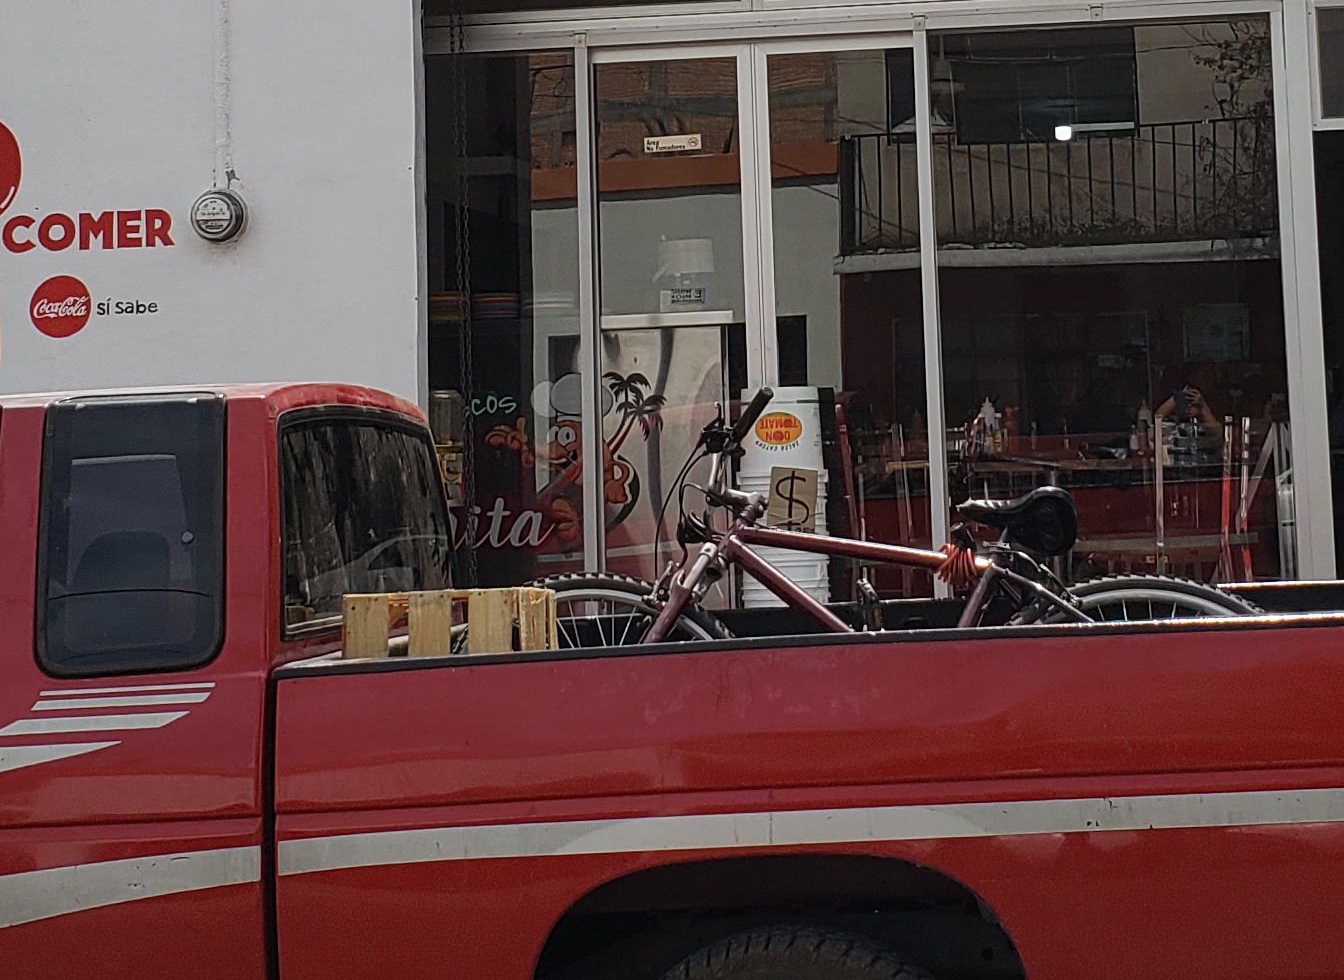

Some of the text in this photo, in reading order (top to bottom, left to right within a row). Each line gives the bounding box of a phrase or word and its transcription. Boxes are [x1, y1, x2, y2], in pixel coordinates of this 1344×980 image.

[2, 208, 175, 254] COMER
[96, 297, 112, 316] sí
[114, 299, 159, 315] sabe
[759, 418, 798, 430] TOMATE
[765, 431, 791, 441] DON
